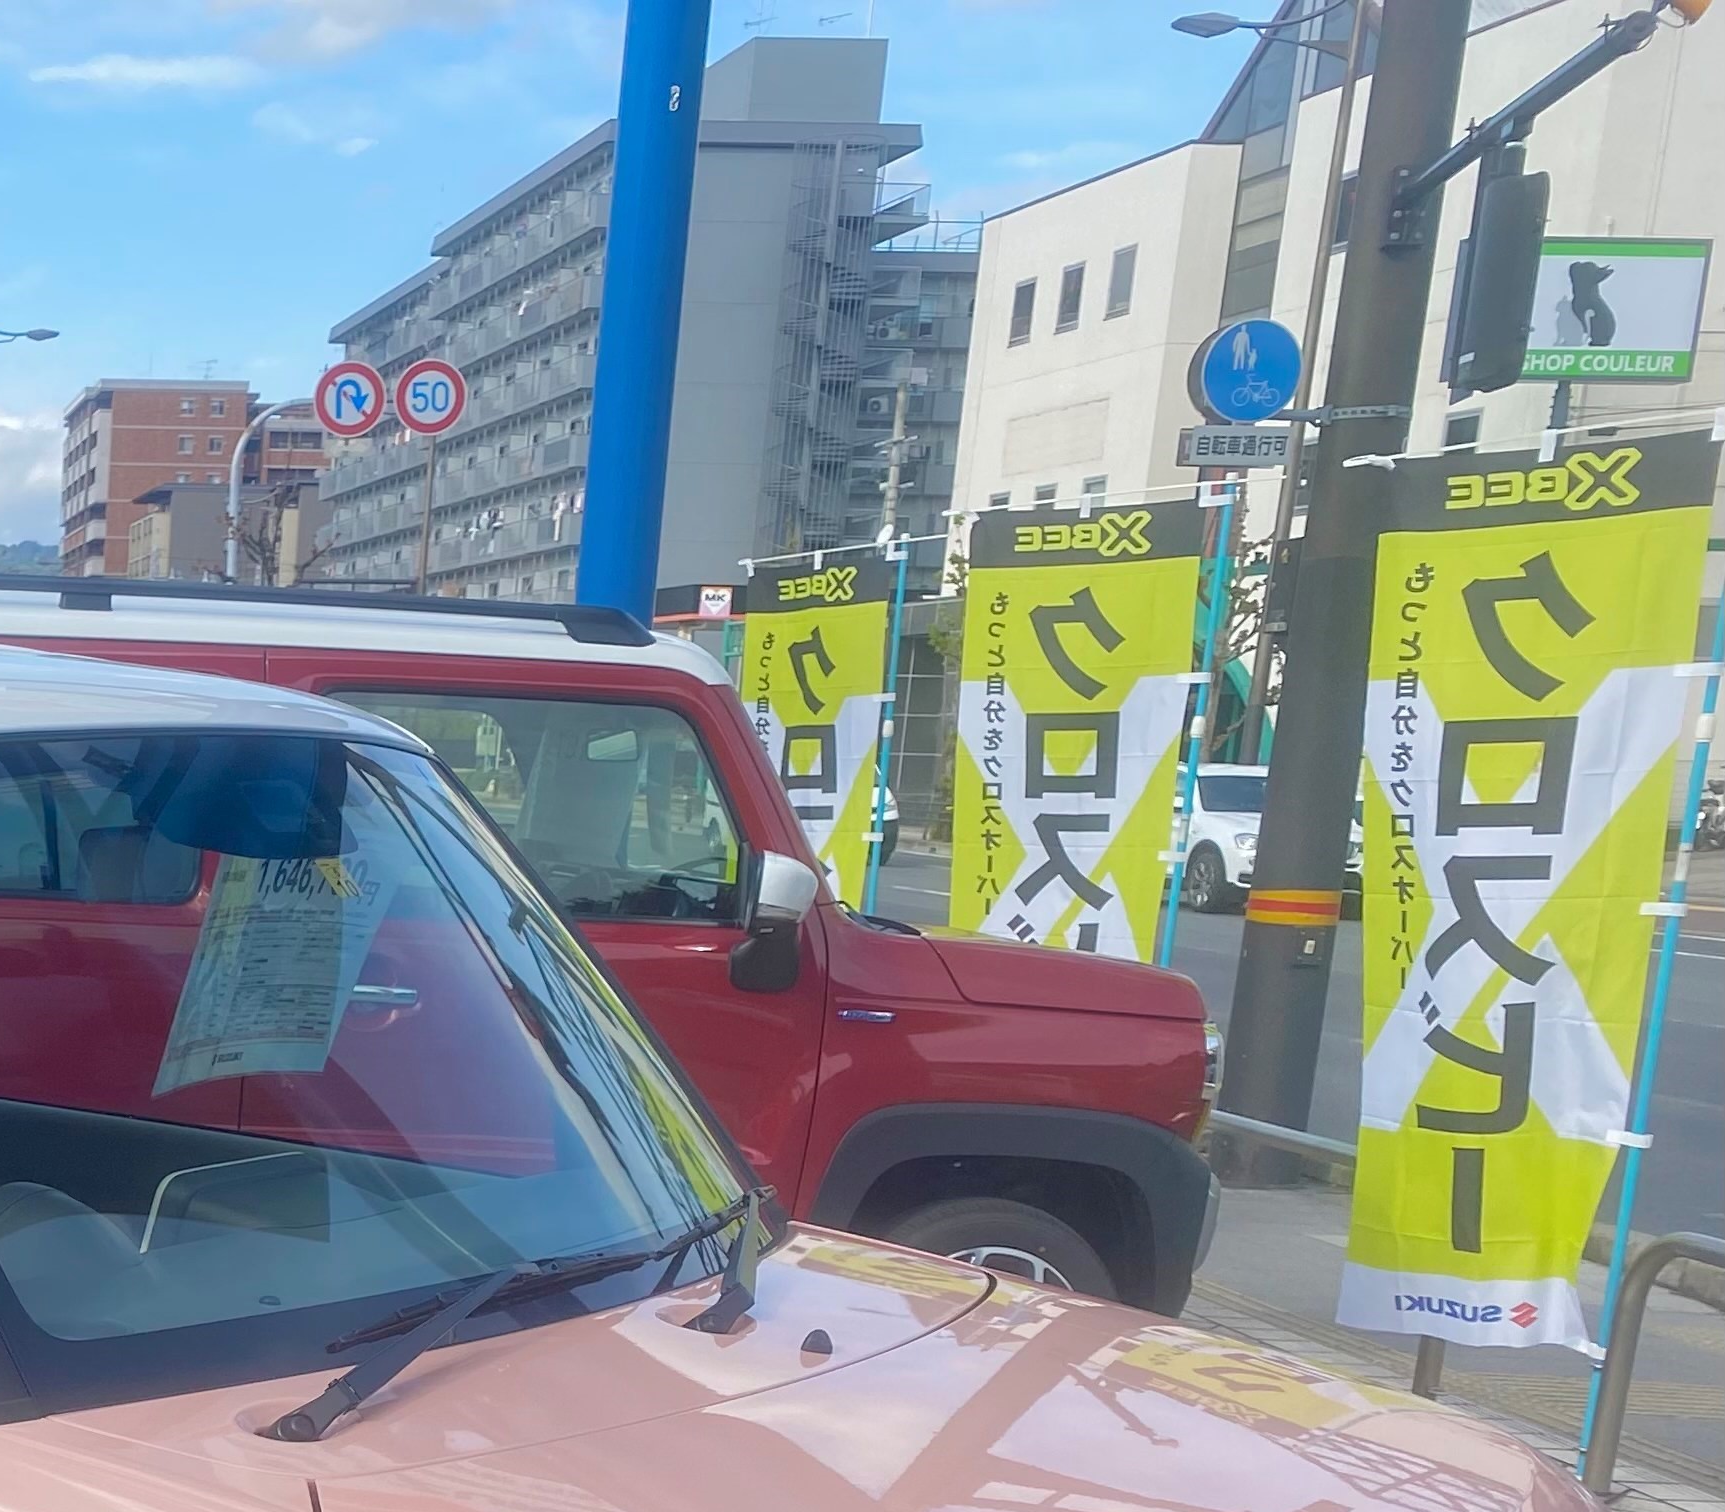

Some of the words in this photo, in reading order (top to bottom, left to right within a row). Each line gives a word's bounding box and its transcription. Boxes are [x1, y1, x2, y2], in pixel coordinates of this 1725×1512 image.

[1523, 354, 1575, 371] SHOP
[1579, 355, 1674, 373] COULEUR
[411, 381, 450, 413] 50
[1196, 434, 1289, 456] 自転車通行可
[704, 593, 727, 602] MK
